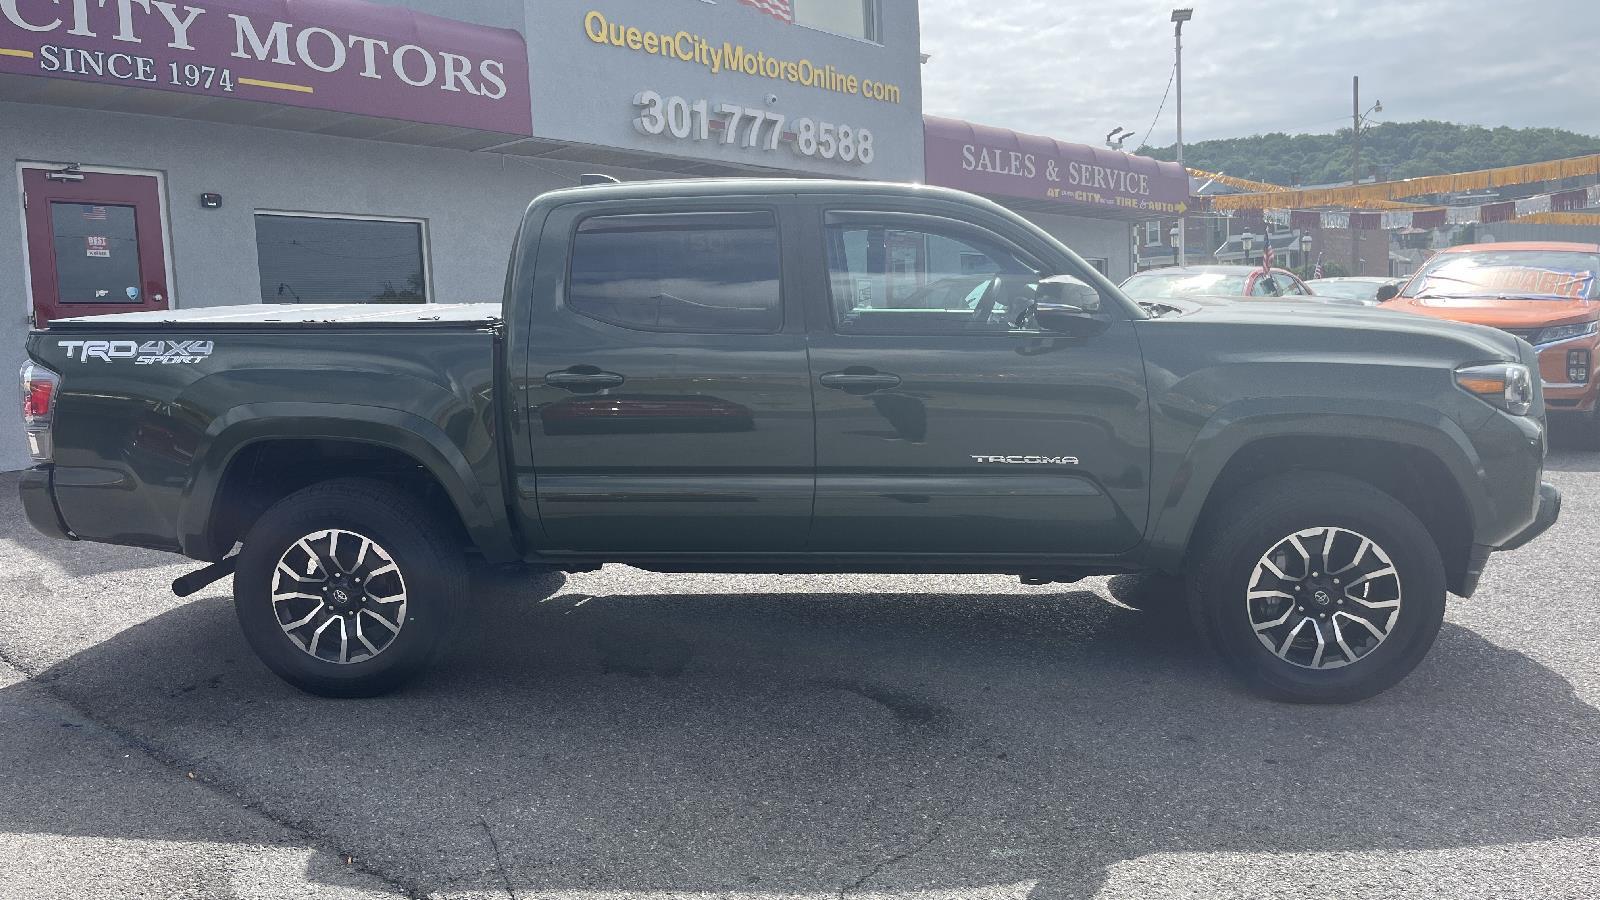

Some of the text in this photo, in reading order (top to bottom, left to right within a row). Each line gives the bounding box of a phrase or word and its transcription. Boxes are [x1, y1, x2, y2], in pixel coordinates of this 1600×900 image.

[0, 0, 507, 100] CITY MOTORS
[584, 10, 901, 104] QueenCityMotorsOnline com
[40, 44, 234, 93] SINCE 1974
[962, 144, 1150, 196] SALES & SERVICE
[1075, 190, 1101, 204] CITY
[1115, 196, 1138, 209] TIRE
[1148, 200, 1174, 213] AUTO
[58, 340, 139, 364] TRD
[135, 355, 209, 365] SPORT
[969, 454, 1079, 465] TACOMA
